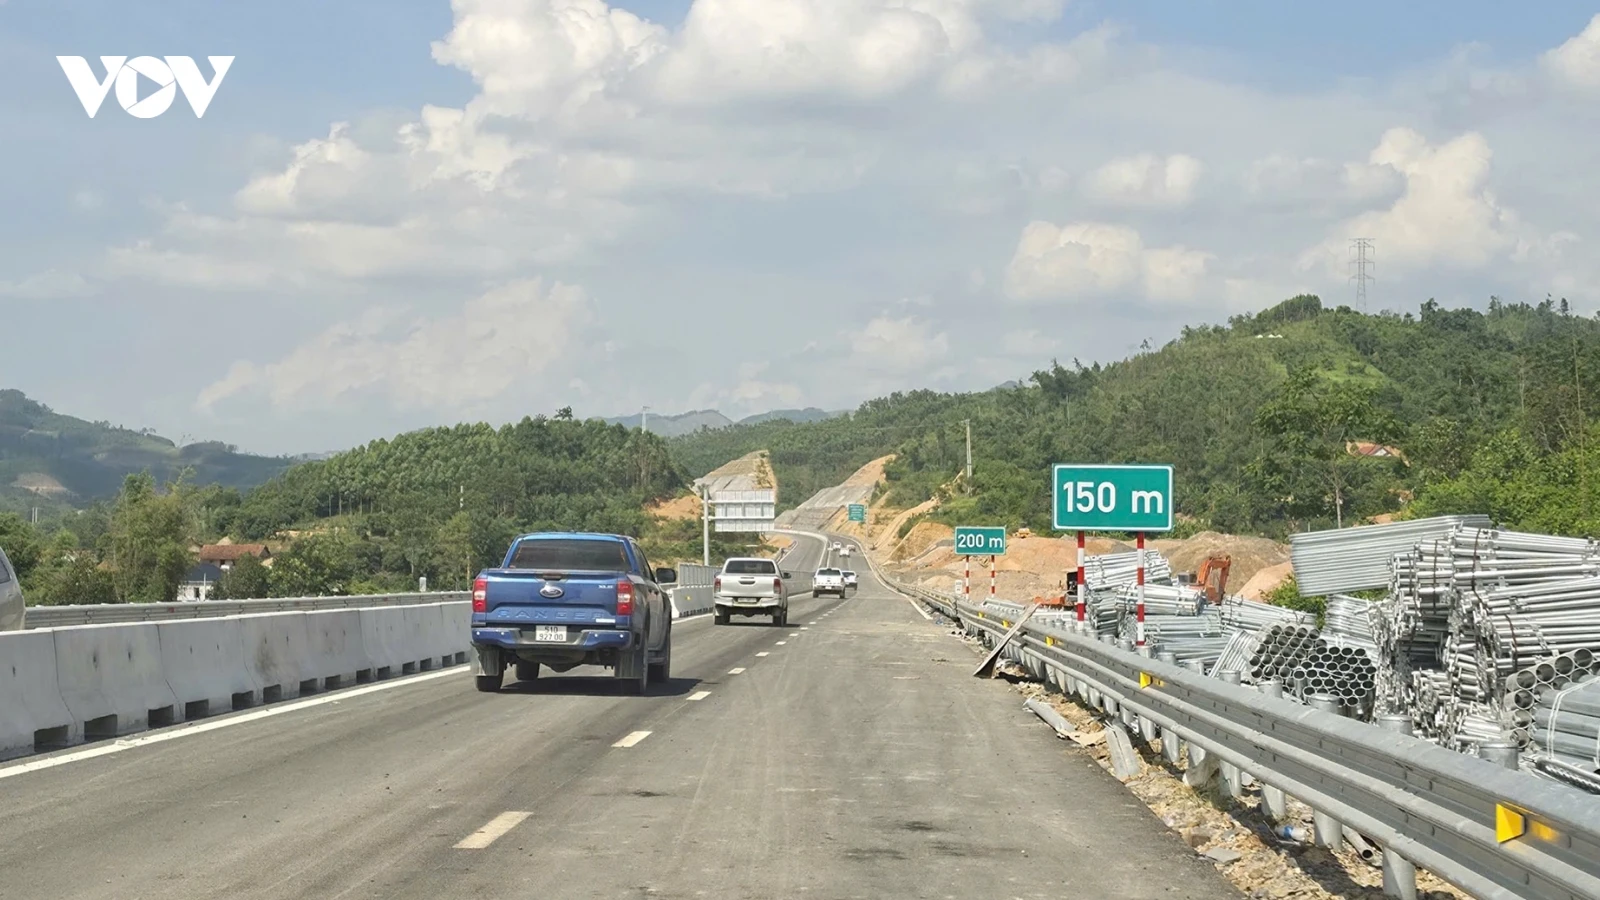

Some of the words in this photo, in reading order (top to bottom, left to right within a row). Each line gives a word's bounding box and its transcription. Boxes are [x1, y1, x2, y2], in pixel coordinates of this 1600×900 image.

[1063, 481, 1116, 514] 150
[1131, 490, 1164, 514] m
[957, 534, 984, 548] 200
[988, 537, 1003, 548] m
